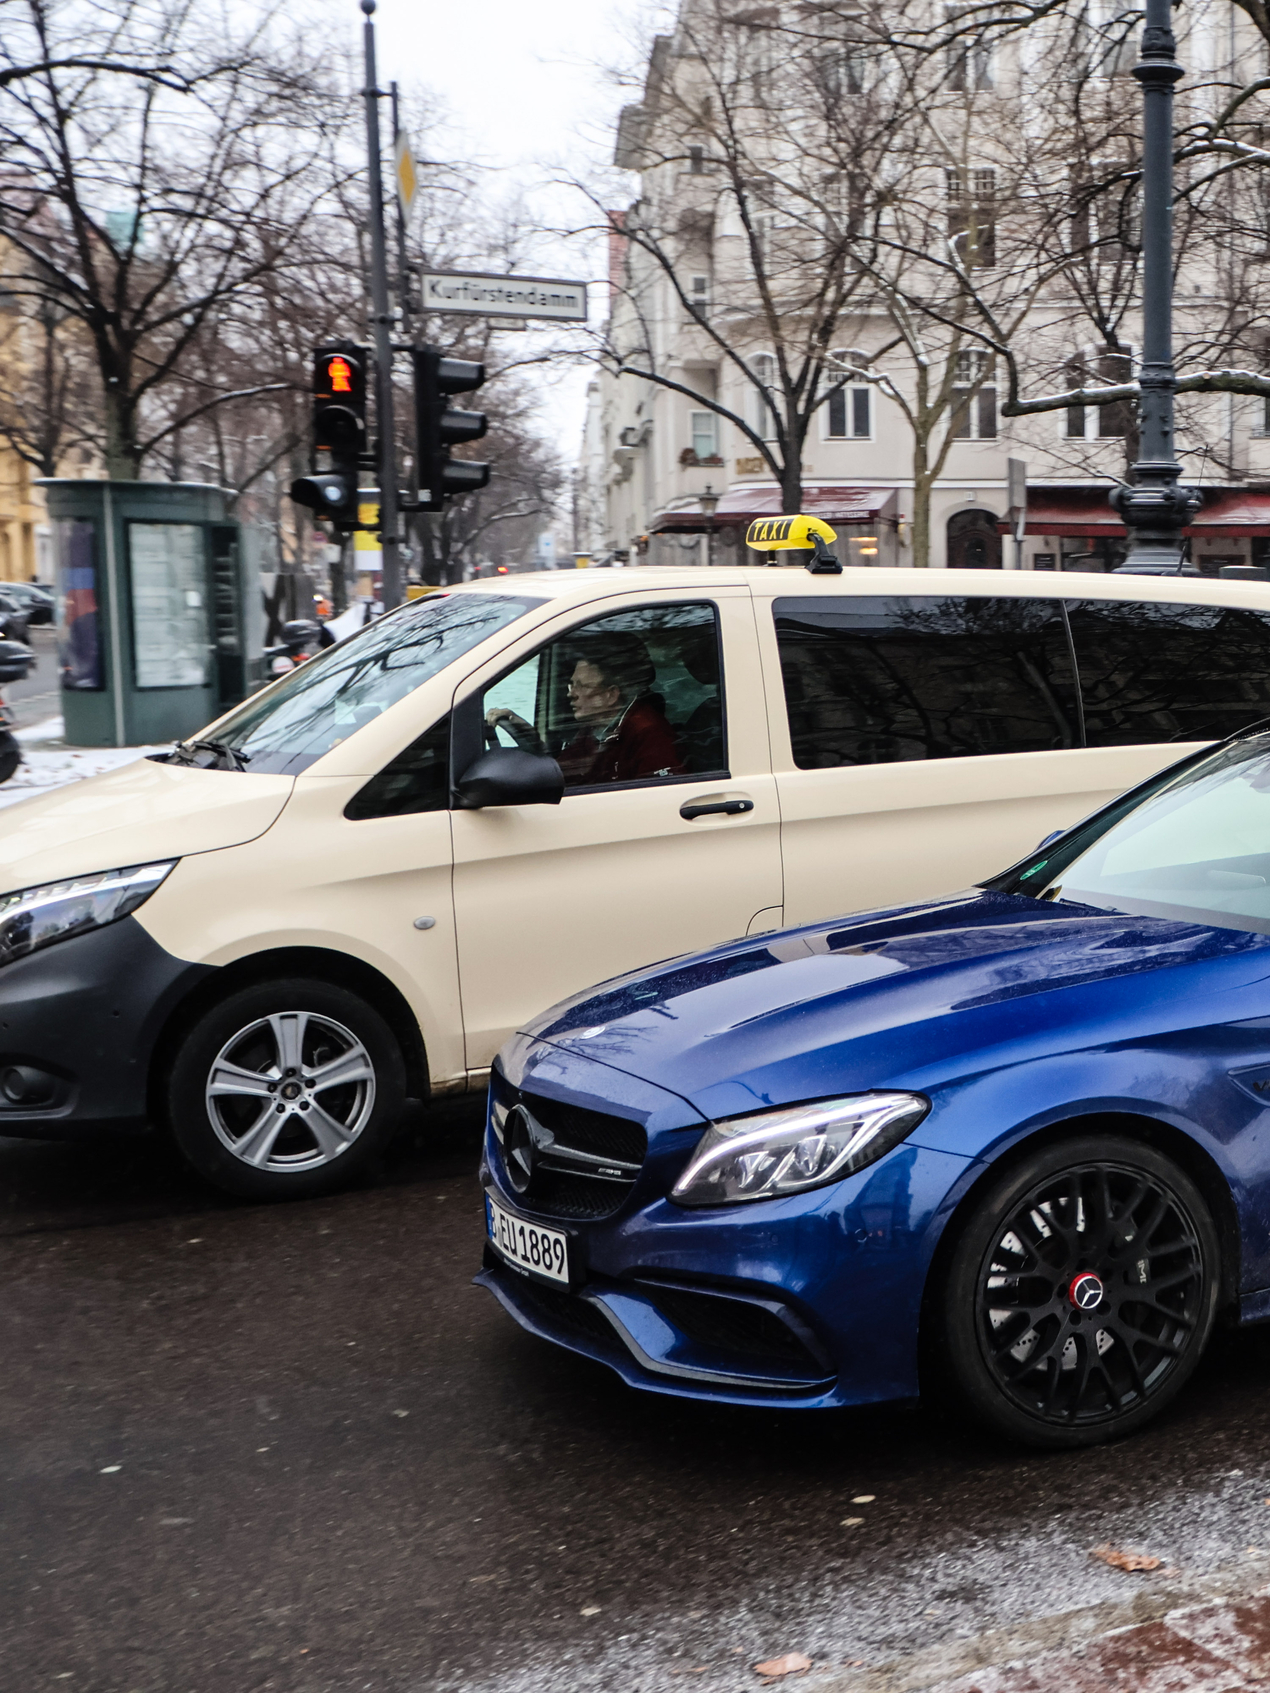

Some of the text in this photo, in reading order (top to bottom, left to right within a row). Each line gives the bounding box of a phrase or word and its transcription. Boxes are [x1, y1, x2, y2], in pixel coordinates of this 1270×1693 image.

[429, 279, 578, 308] Kurfürstendamm
[753, 520, 788, 541] TAXI
[500, 1212, 518, 1257] EU
[519, 1225, 565, 1275] 1889
